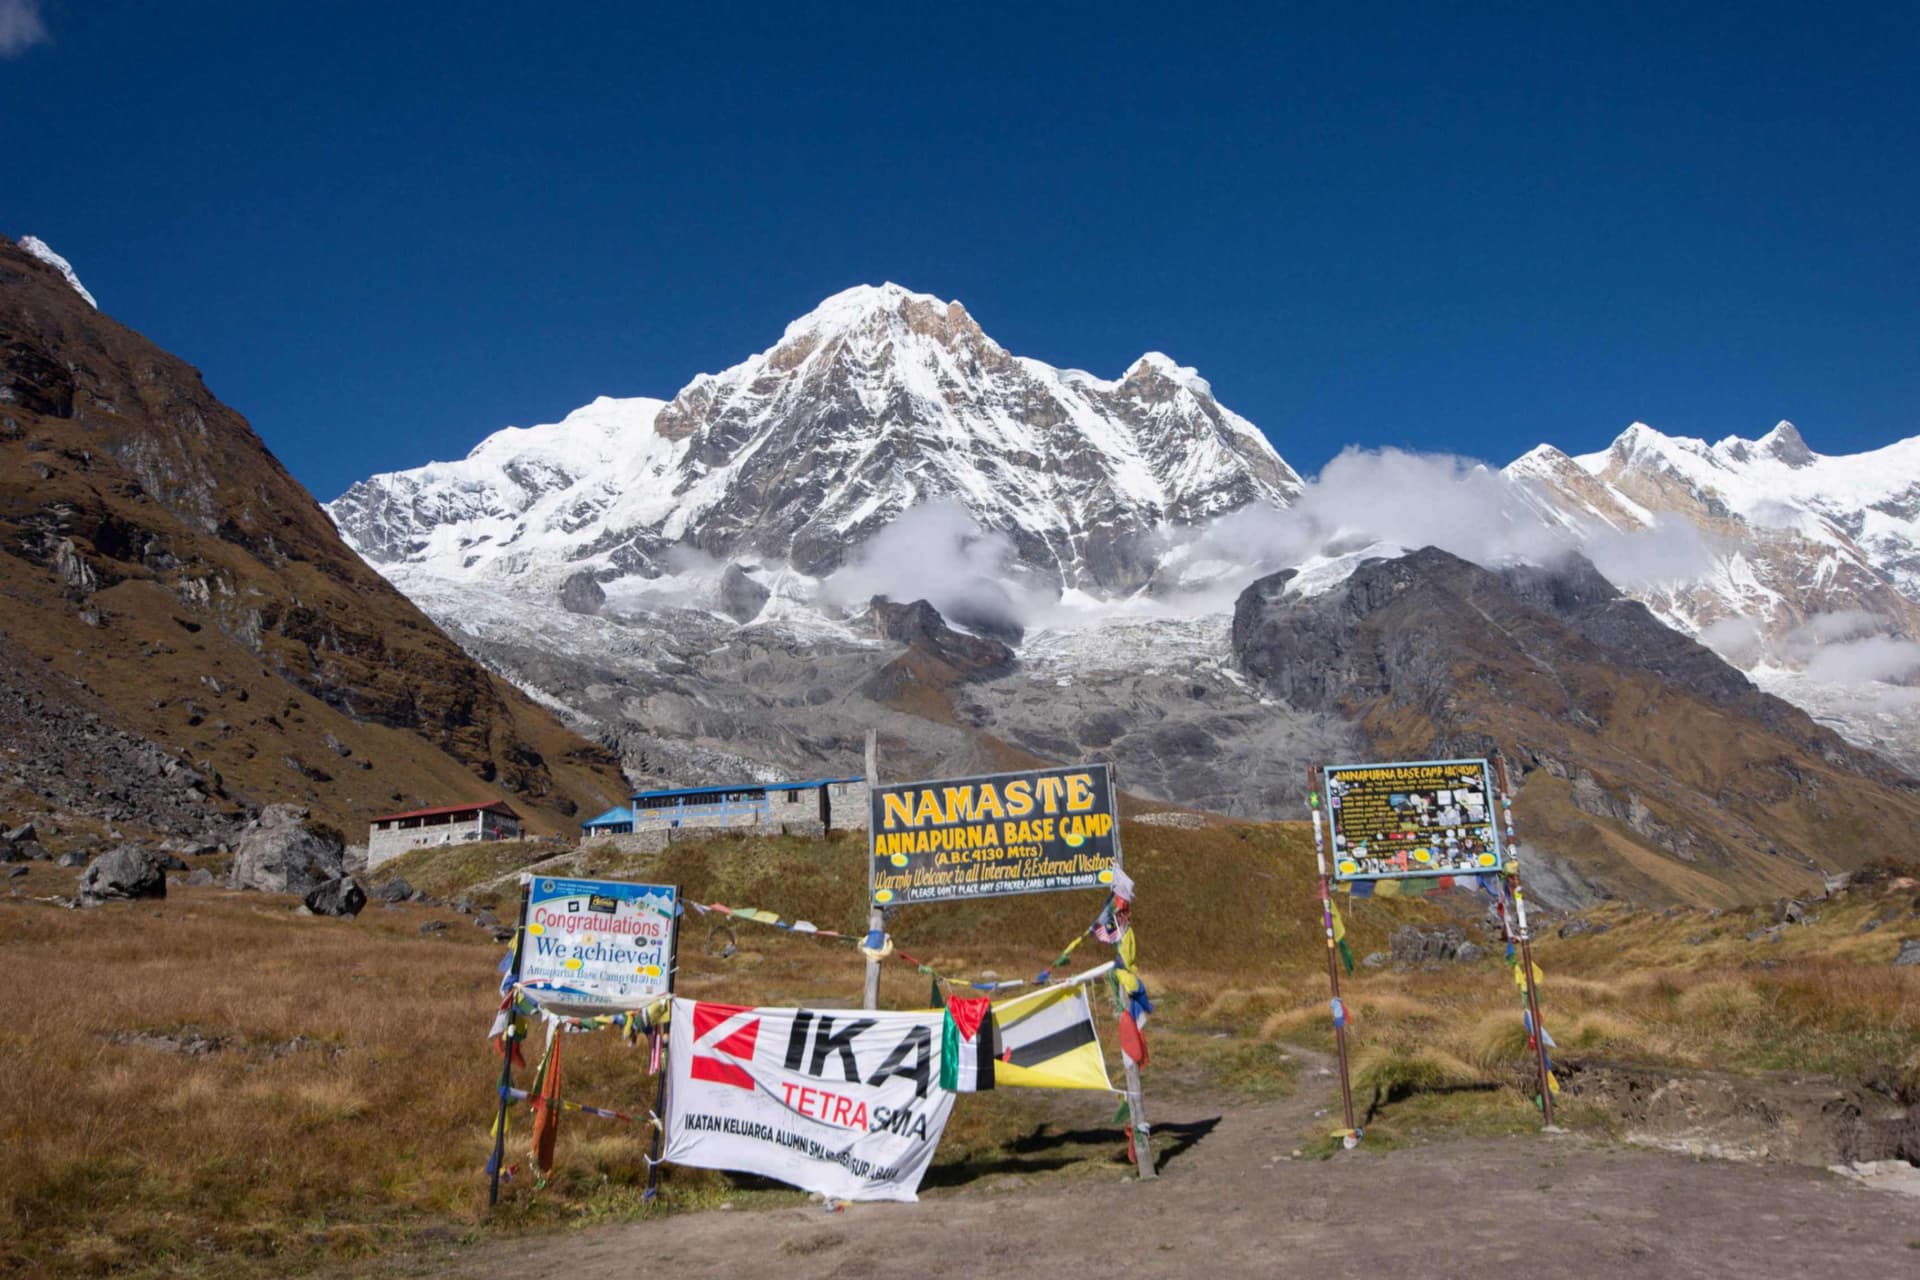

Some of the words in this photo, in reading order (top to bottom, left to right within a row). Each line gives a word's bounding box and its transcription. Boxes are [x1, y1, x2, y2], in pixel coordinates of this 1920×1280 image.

[1336, 768, 1395, 782] ANNAPURNA
[1395, 767, 1420, 780] BASE
[1421, 766, 1443, 779] CAMP
[883, 773, 1095, 829] NAMASTE
[875, 823, 999, 856] ANNAPURNA
[1004, 818, 1055, 845] BASE
[1059, 813, 1113, 838] CAMP
[874, 868, 912, 892] Warmly
[913, 865, 954, 887] Welcome
[955, 864, 965, 883] to
[965, 862, 980, 882] all
[980, 859, 1022, 881] Internal
[958, 882, 979, 895] PLACE
[534, 906, 660, 938] Congratulations
[536, 935, 567, 959] We
[784, 1008, 931, 1099] IKA
[684, 1112, 722, 1134] IKATAN
[723, 1117, 773, 1144] KELUARGA
[775, 1126, 809, 1153] ALUMNI
